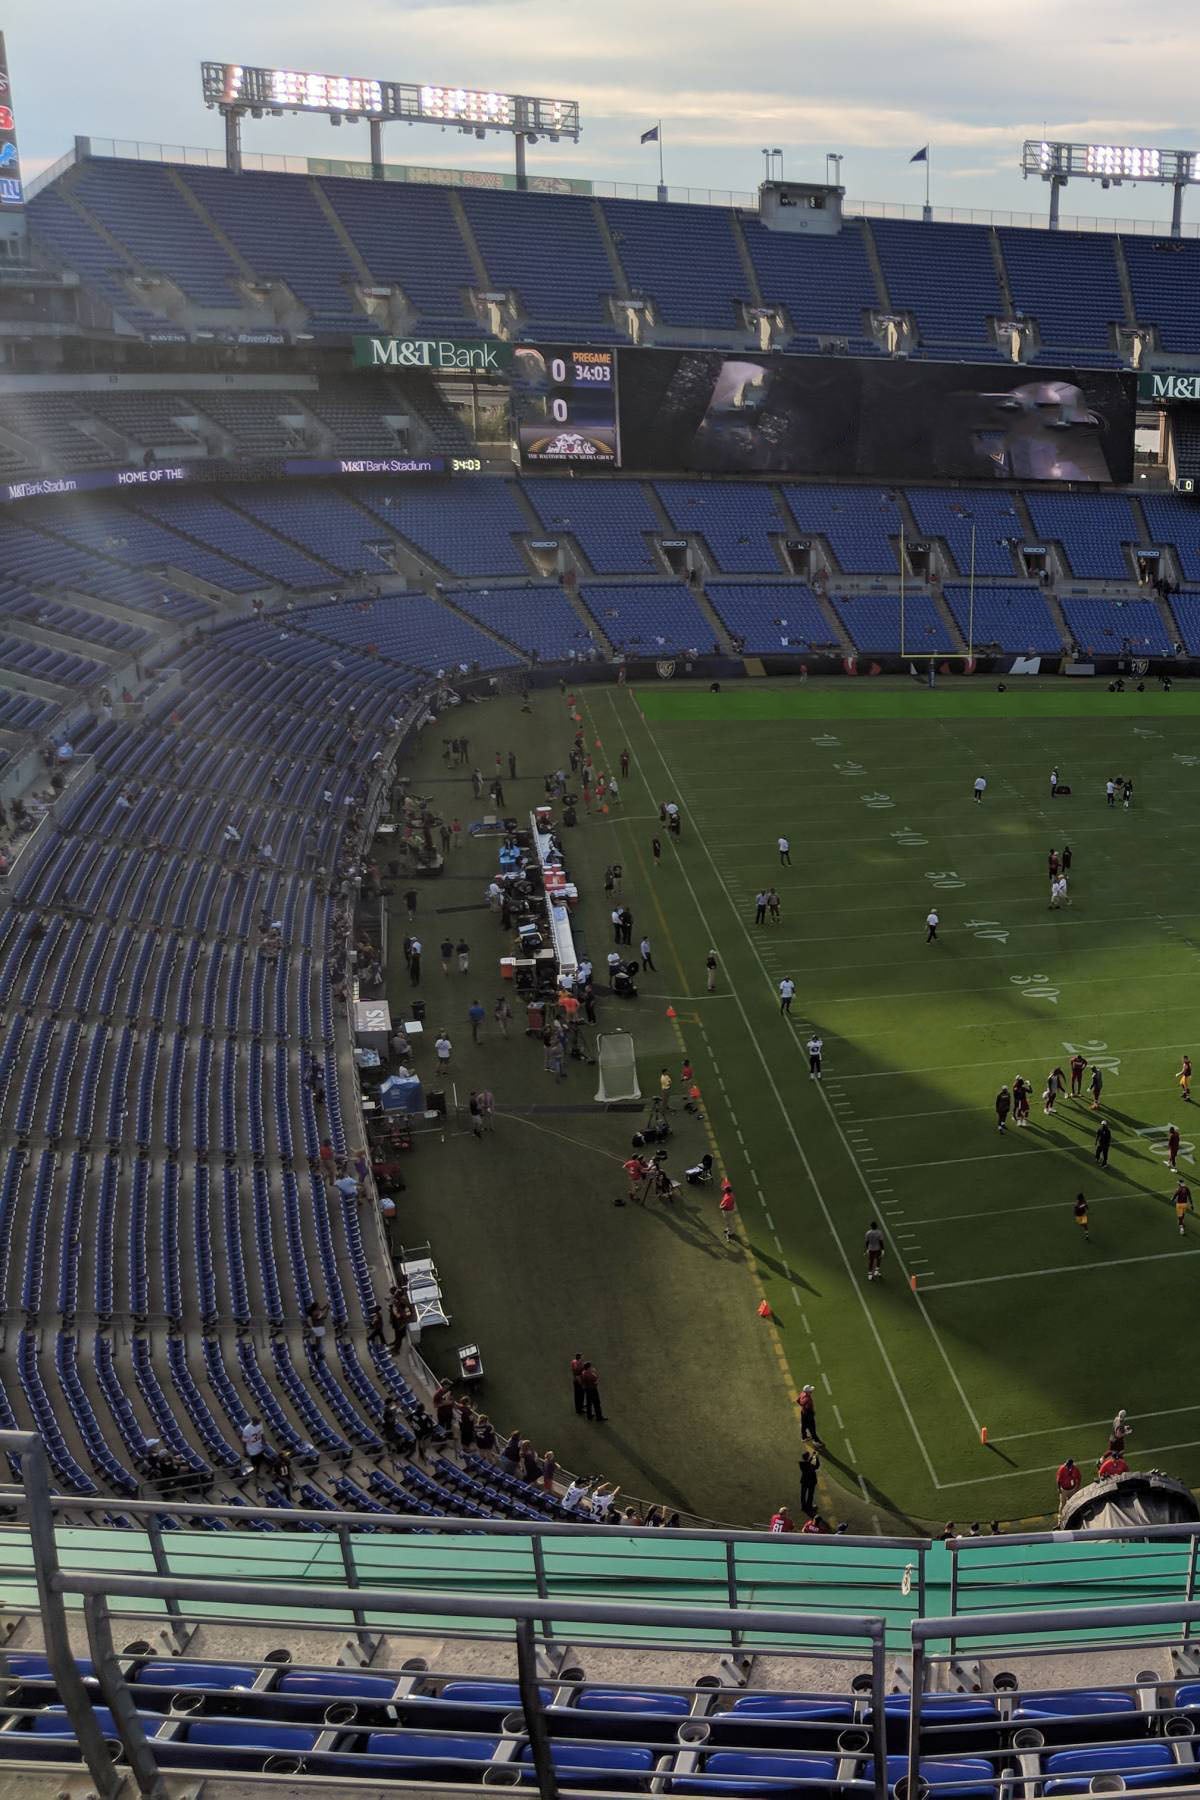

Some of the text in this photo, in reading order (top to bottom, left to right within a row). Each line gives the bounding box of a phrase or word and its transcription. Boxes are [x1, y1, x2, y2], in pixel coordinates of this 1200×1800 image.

[371, 339, 499, 368] M&T Bank
[572, 352, 612, 364] PREGAME
[552, 358, 611, 382] 0 34:03
[553, 399, 568, 422] 0
[341, 460, 431, 472] M&T Bank Stadium
[453, 459, 481, 471] 34:03
[9, 468, 184, 499] M&T Bank Stadium HOME OF THE
